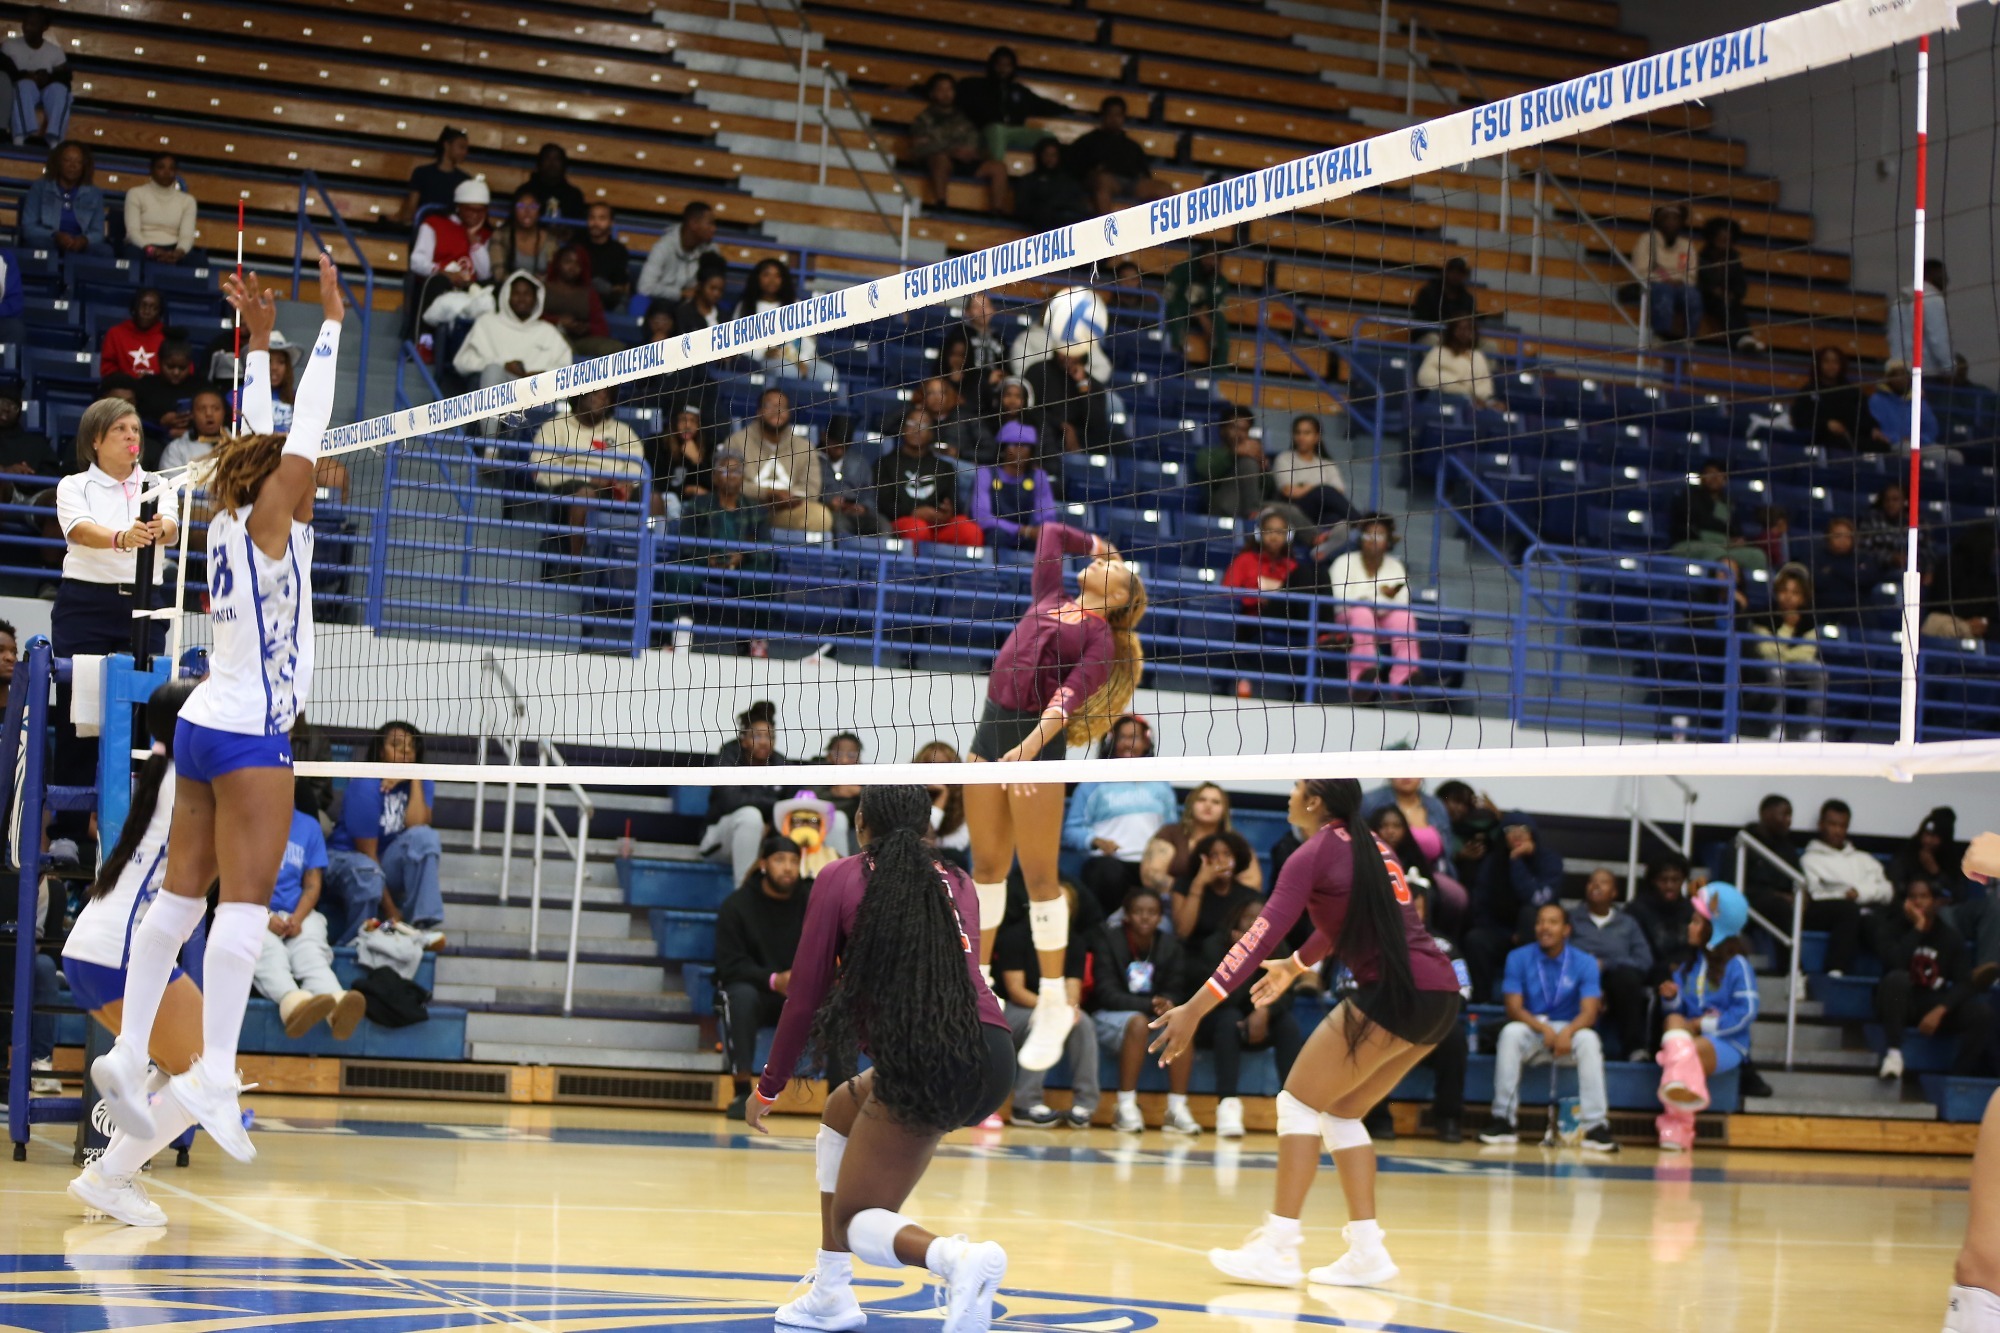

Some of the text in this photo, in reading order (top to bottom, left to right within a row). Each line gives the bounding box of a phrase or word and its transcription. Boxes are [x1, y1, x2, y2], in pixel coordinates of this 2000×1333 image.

[1471, 22, 1768, 146] FSU BRONCO VOLLEYBALL
[1150, 142, 1372, 235] FSU BRONCO VOLLEYBALL
[905, 226, 1076, 300] FSU BRONCO VOLLEYBALL
[711, 290, 847, 352] FSU BRONCO VOLLEYBALL
[555, 341, 665, 392] FSU BRONCO VOLLEYBALL
[360, 414, 397, 443] VOLLEYBALL
[428, 381, 517, 426] FSU BRONCO VOLLEYBALL
